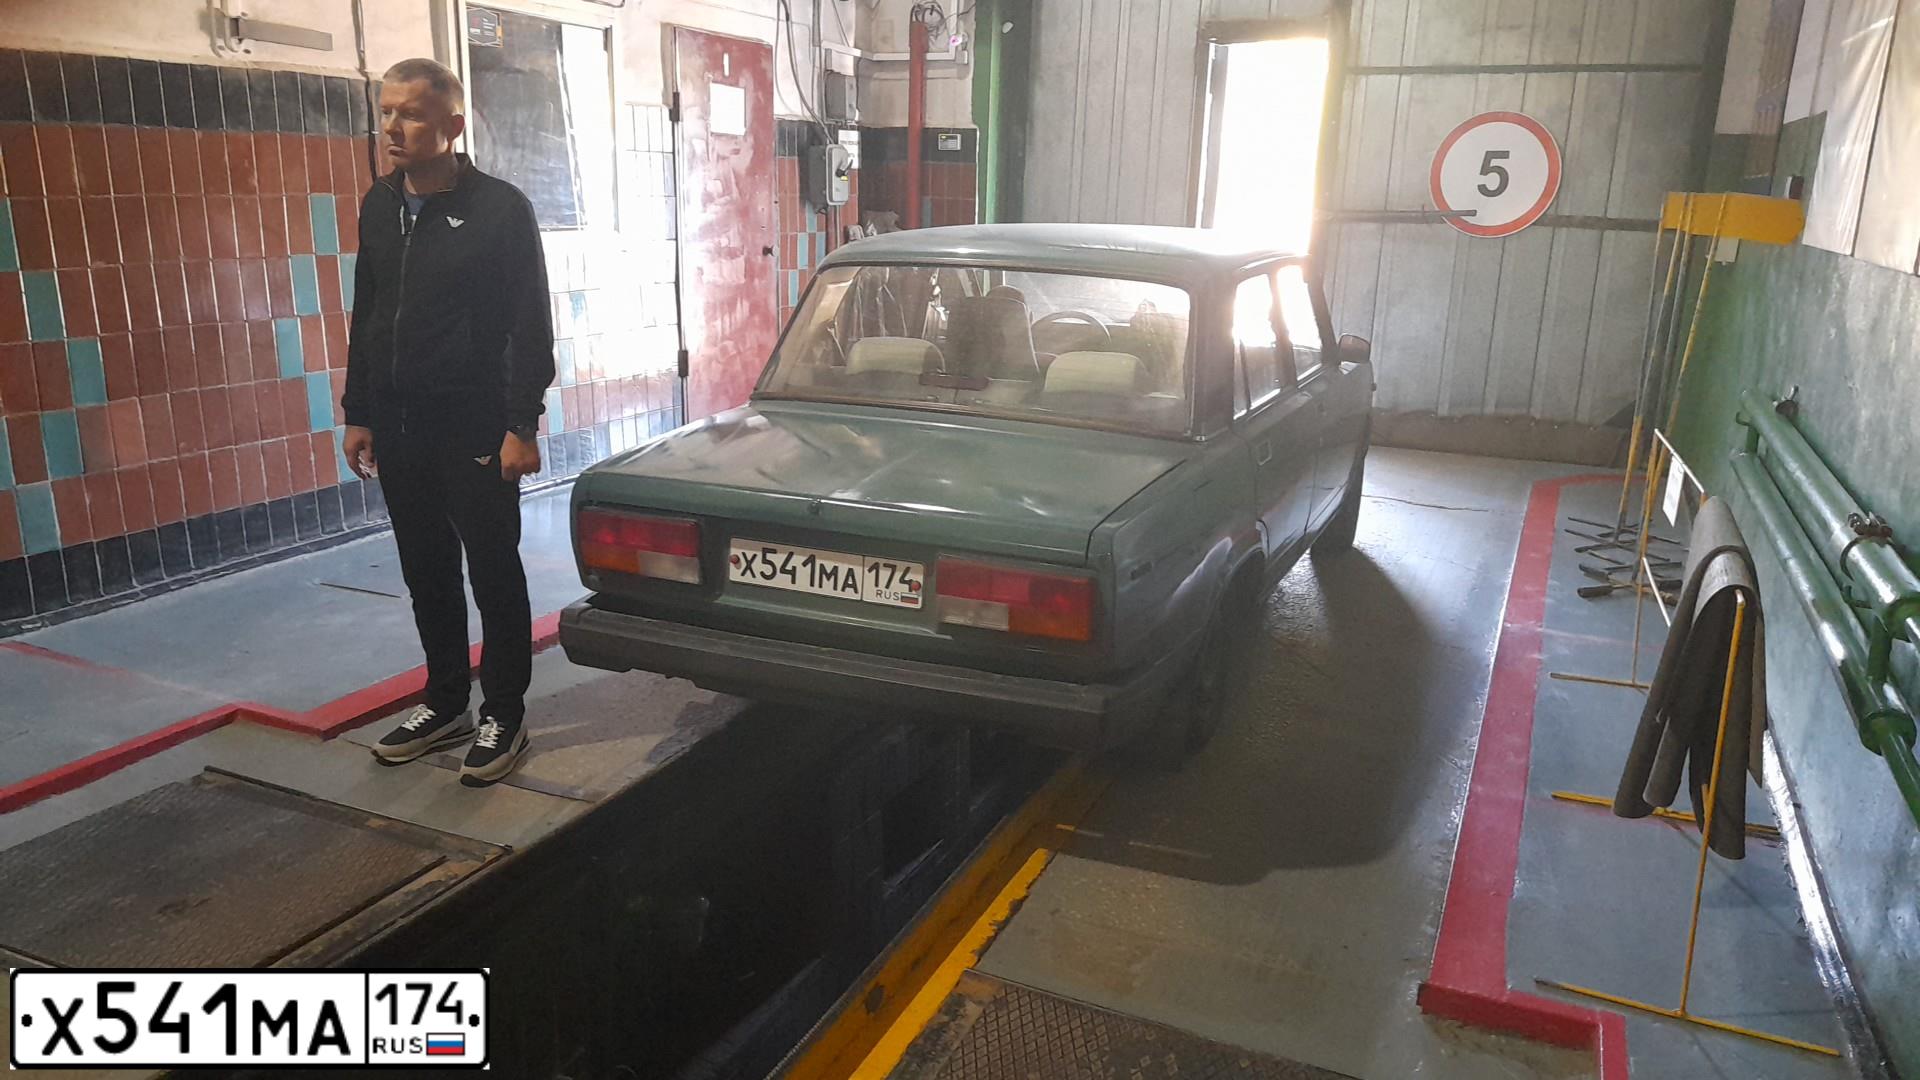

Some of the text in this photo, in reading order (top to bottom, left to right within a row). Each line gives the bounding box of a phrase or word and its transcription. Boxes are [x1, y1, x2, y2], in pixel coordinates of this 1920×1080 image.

[1477, 150, 1510, 198] 5
[740, 547, 915, 594] Х541МА 174
[875, 589, 899, 601] RUS
